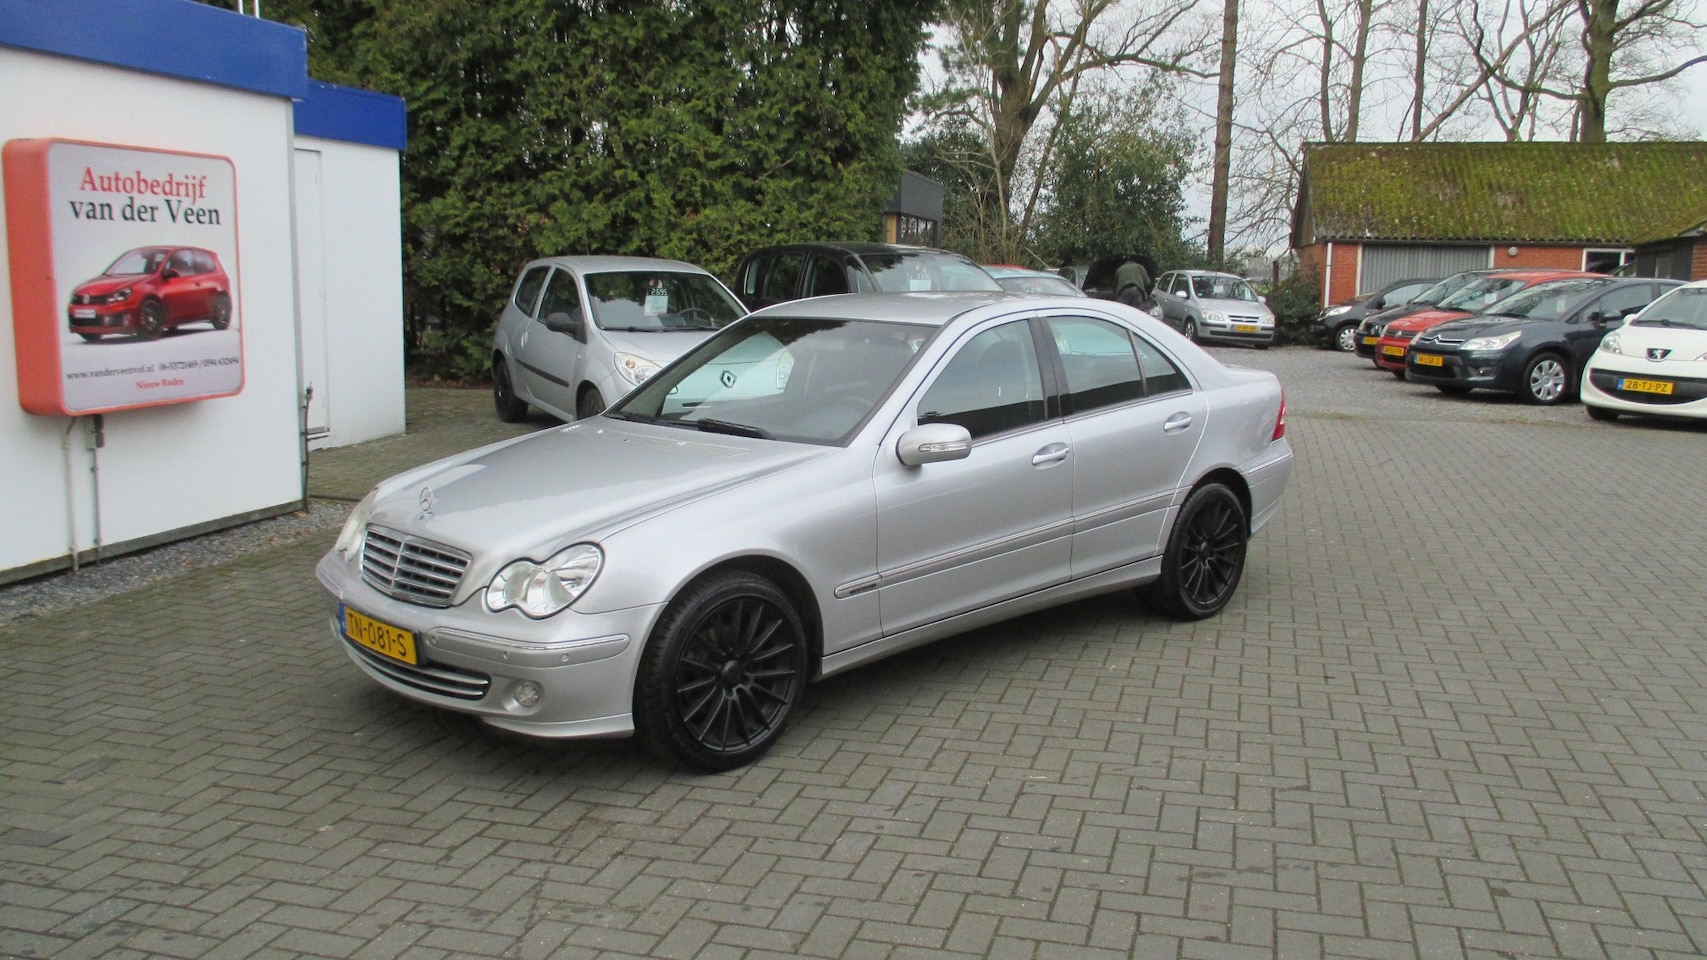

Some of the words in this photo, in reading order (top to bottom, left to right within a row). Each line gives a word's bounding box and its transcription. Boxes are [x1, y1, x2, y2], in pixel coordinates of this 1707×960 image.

[80, 166, 206, 205] Autobedrijf
[69, 200, 115, 221] van
[122, 196, 158, 222] der
[164, 199, 222, 225] Veen
[1626, 380, 1668, 392] 28-TJ-PZ
[347, 612, 407, 657] TN-081-S
